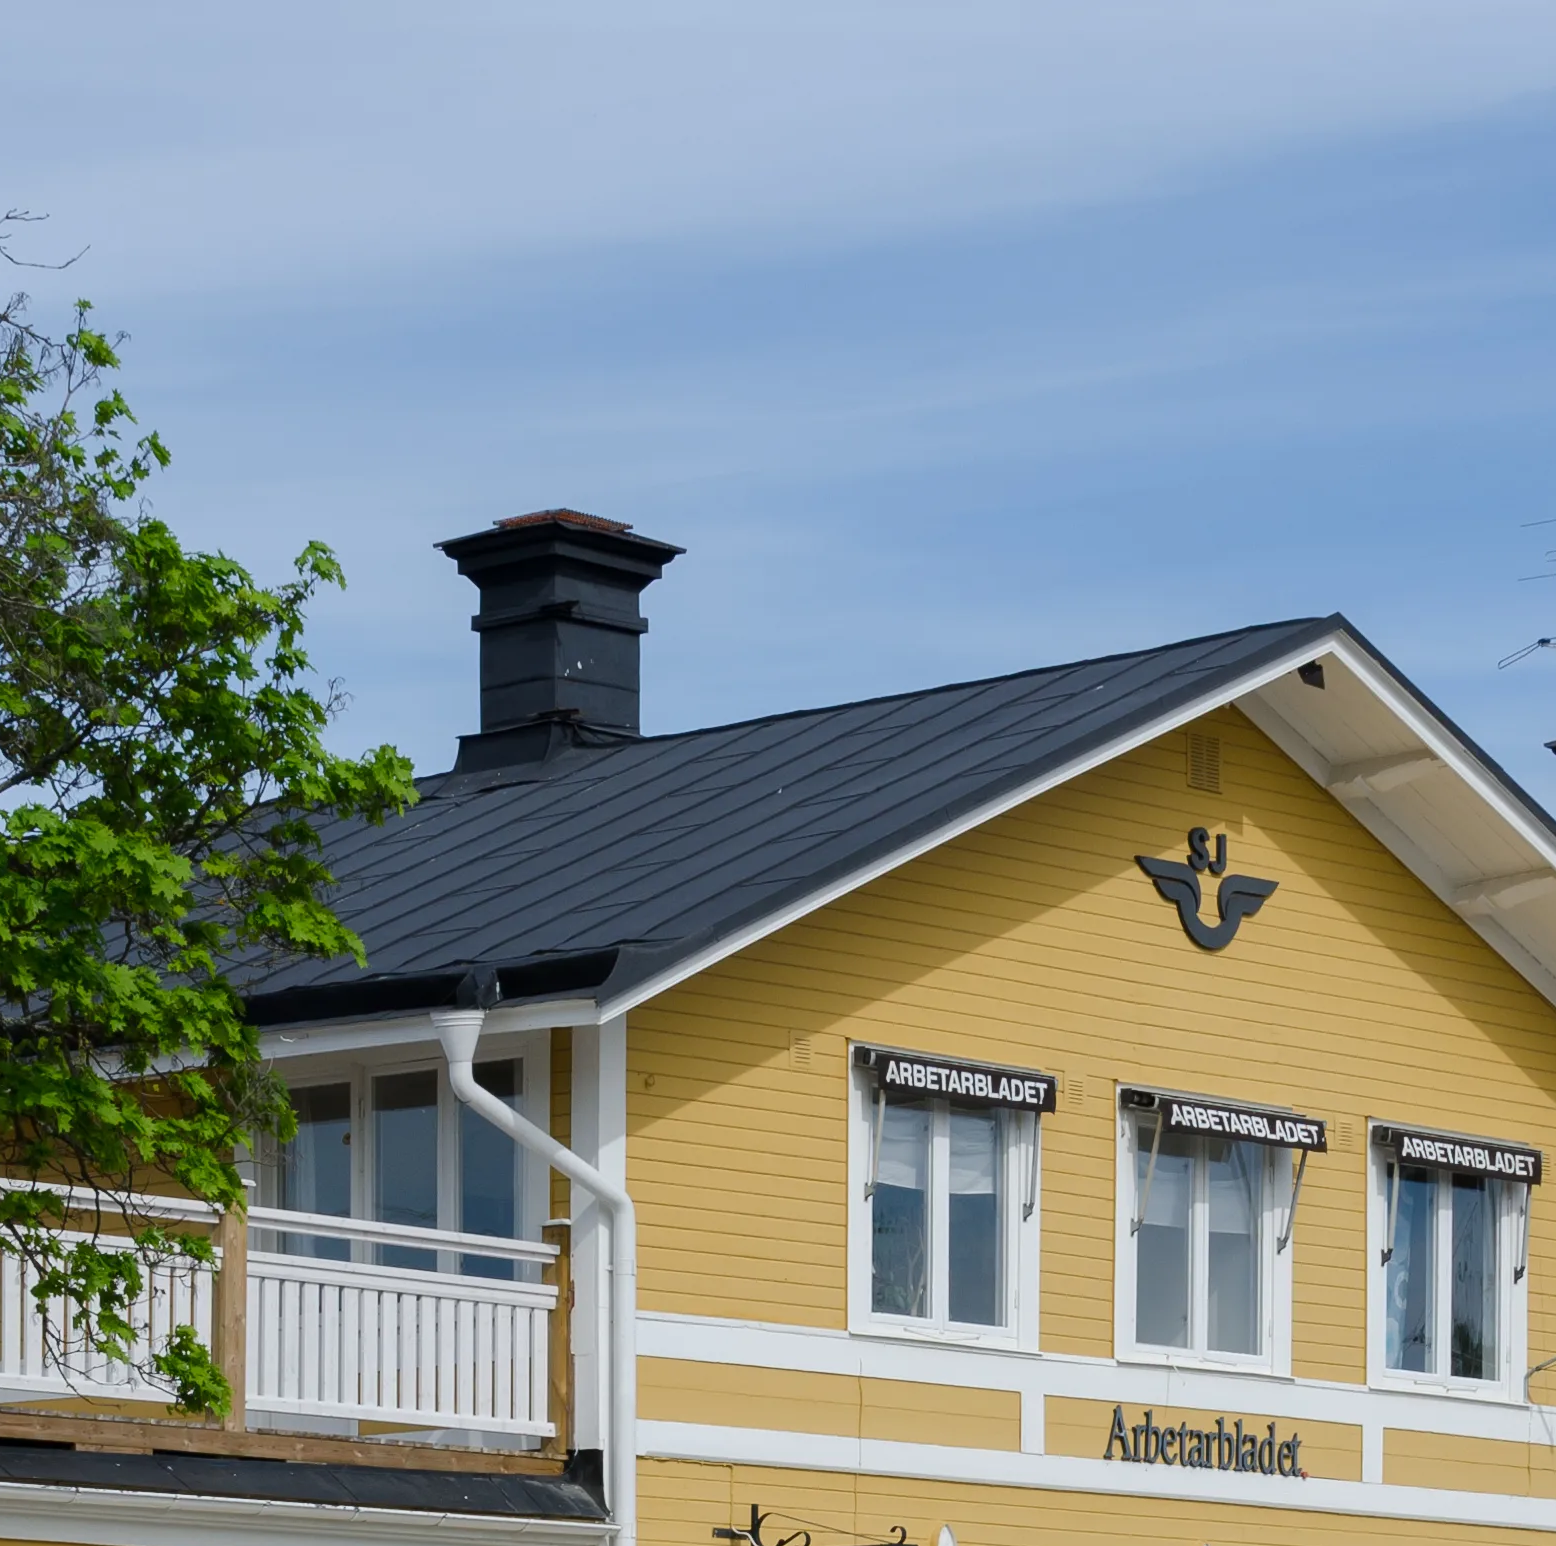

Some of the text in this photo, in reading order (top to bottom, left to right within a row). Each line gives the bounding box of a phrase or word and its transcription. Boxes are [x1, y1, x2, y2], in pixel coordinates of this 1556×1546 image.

[1186, 827, 1227, 875] SJ
[885, 1060, 1048, 1105] ARBETARBLADET
[1170, 1103, 1319, 1145] ARBETARBLADET
[1401, 1136, 1535, 1177] ARBETARBLADET
